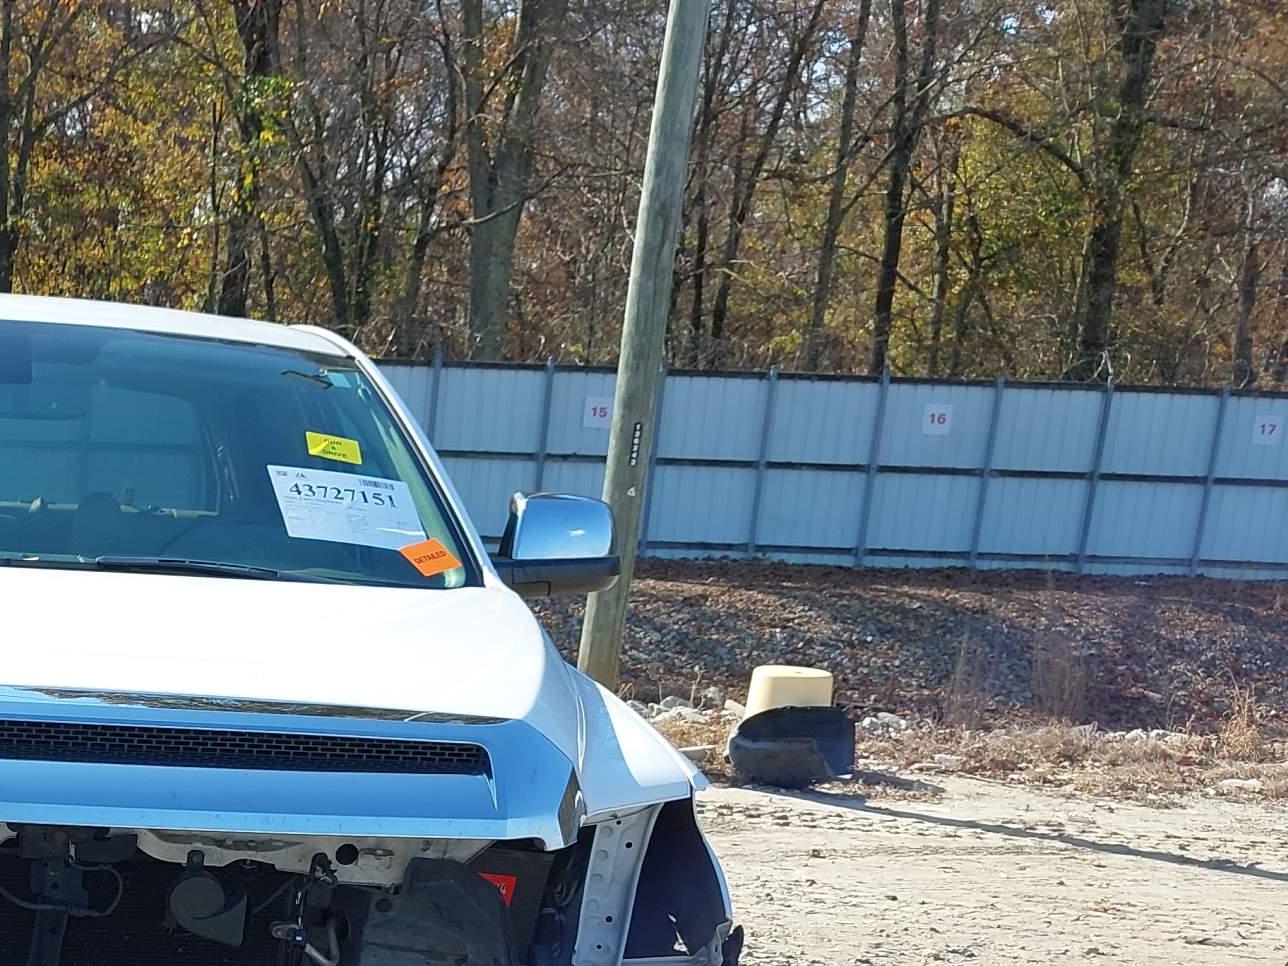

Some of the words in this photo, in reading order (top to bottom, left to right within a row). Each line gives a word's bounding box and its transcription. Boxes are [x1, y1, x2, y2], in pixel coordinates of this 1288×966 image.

[591, 406, 608, 418] 15
[928, 413, 947, 425] 16
[1259, 423, 1278, 435] 17
[289, 483, 397, 508] 43727151
[414, 550, 447, 564] DETAILED
